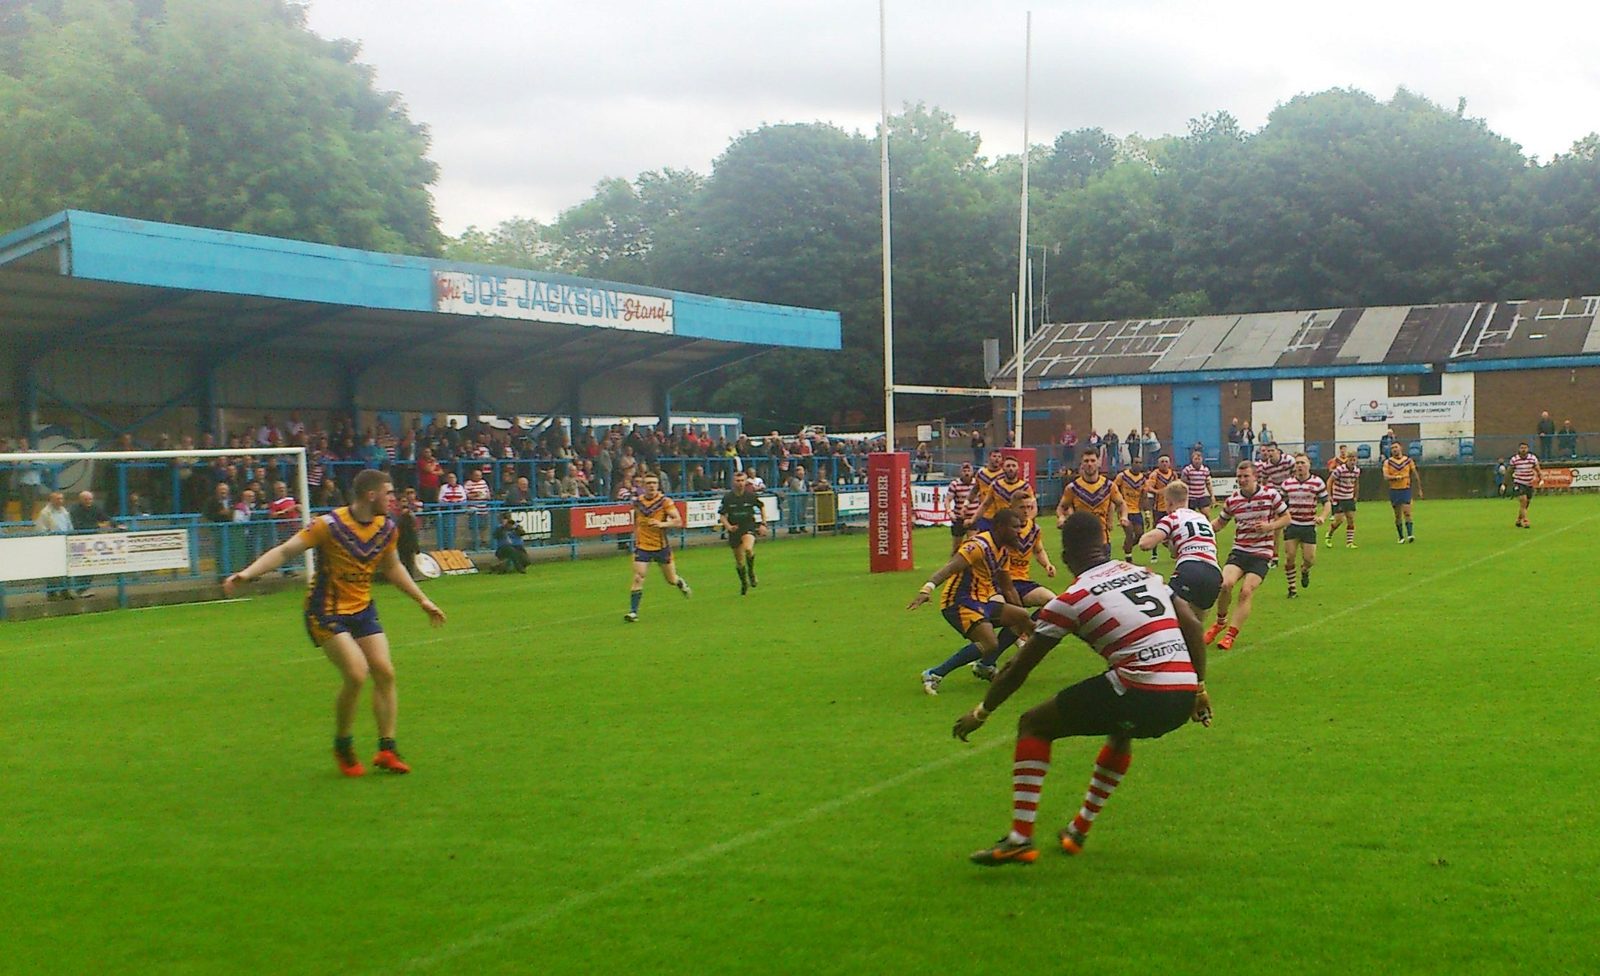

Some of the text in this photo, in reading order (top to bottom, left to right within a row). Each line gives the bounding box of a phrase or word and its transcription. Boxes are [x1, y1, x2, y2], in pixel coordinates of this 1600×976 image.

[463, 274, 508, 306] JOE
[517, 278, 619, 319] JACKSON
[624, 298, 668, 322] Stand
[585, 512, 630, 531] Kingstone
[877, 475, 889, 555] PROPER CIDER
[901, 504, 909, 560] Kingstone
[1184, 521, 1213, 538] 15
[1121, 585, 1166, 618] 5
